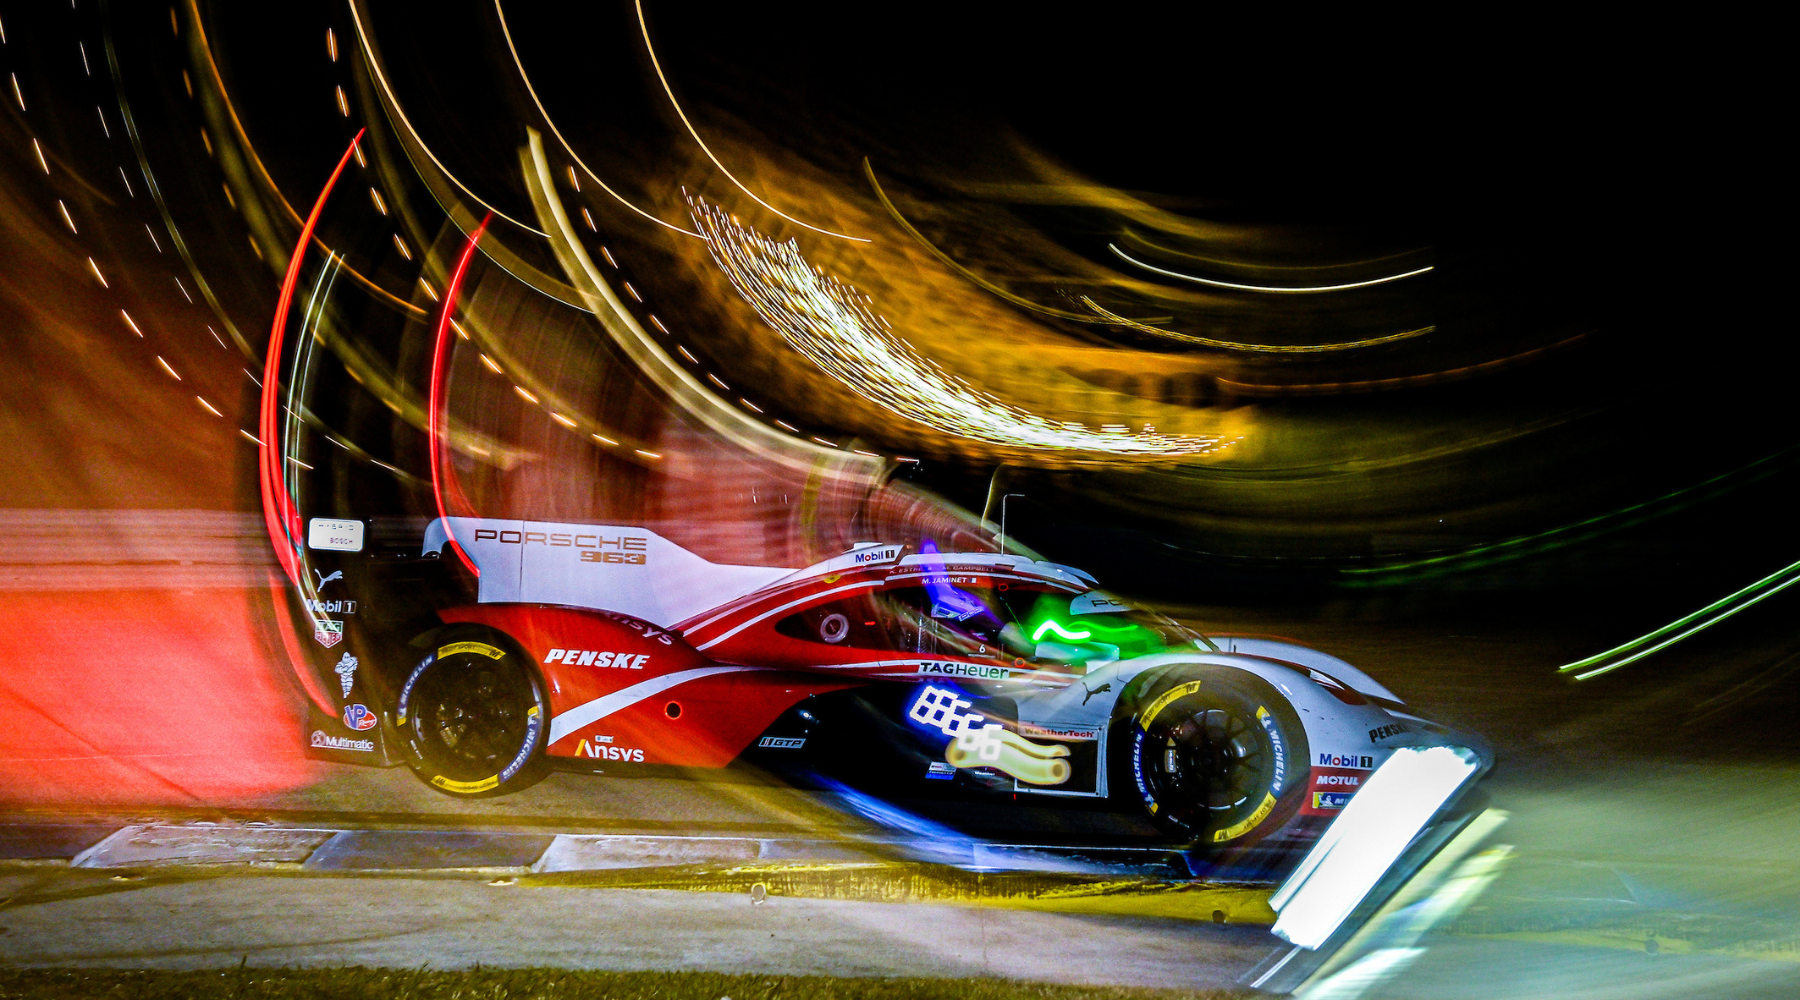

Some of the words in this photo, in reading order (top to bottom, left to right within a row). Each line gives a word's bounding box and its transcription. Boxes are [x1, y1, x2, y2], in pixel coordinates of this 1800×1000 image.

[475, 529, 648, 551] PORSCHE
[580, 551, 647, 565] 963
[855, 550, 884, 563] Mobil
[306, 600, 342, 613] Mobil
[979, 644, 987, 654] 6
[544, 648, 650, 670] PENSKE
[400, 656, 433, 705] MICHELIN
[344, 703, 367, 729] VP
[1024, 727, 1095, 738] WeatherTech
[325, 736, 374, 750] Multimatic
[774, 739, 802, 747] GTP
[502, 728, 536, 780] MICHELIN
[574, 739, 645, 763] Ansys
[1132, 733, 1147, 794] MICHELIN
[1268, 729, 1285, 792] MICHELIN
[1319, 753, 1358, 768] Mobil
[1316, 775, 1359, 786] MOTUL
